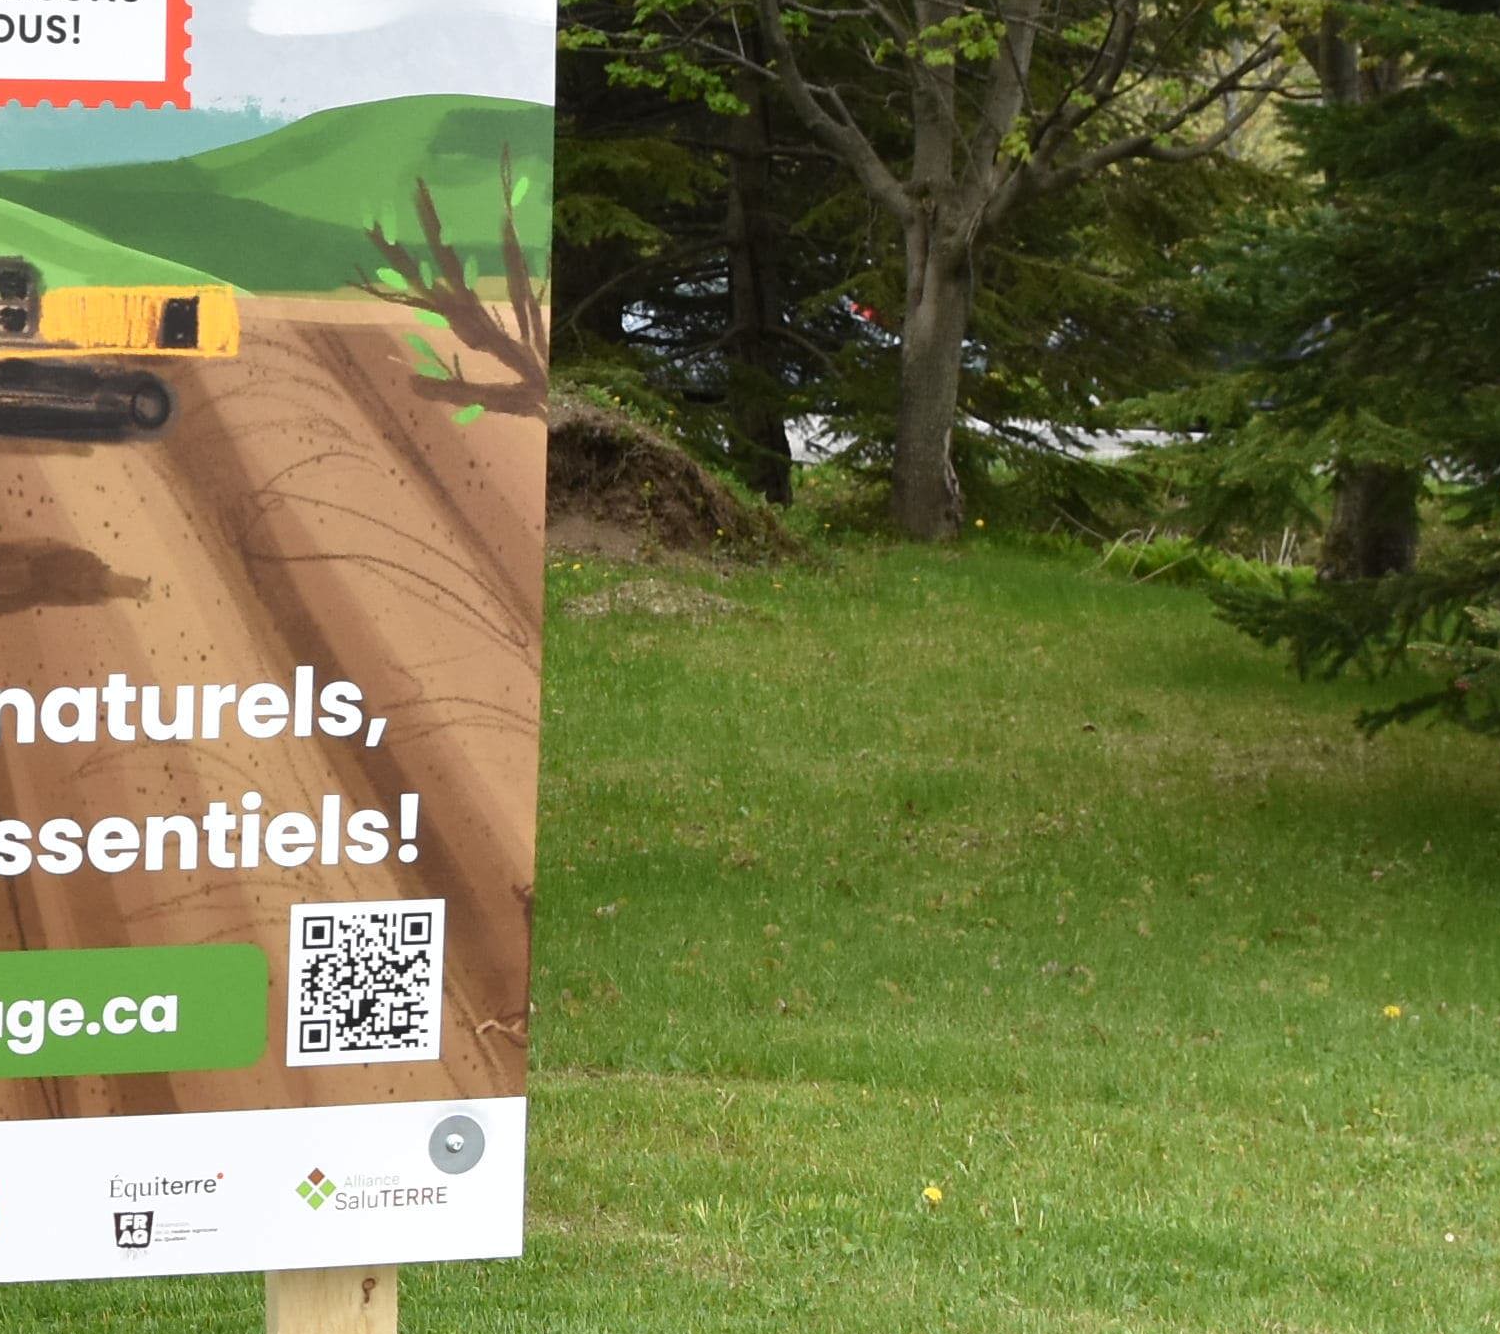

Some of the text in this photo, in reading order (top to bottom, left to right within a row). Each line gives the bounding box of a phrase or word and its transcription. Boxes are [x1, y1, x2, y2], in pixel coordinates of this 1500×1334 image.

[109, 1174, 217, 1202] Équiterre
[344, 1175, 400, 1188] Alliance
[334, 1186, 448, 1211] SaluTERRE
